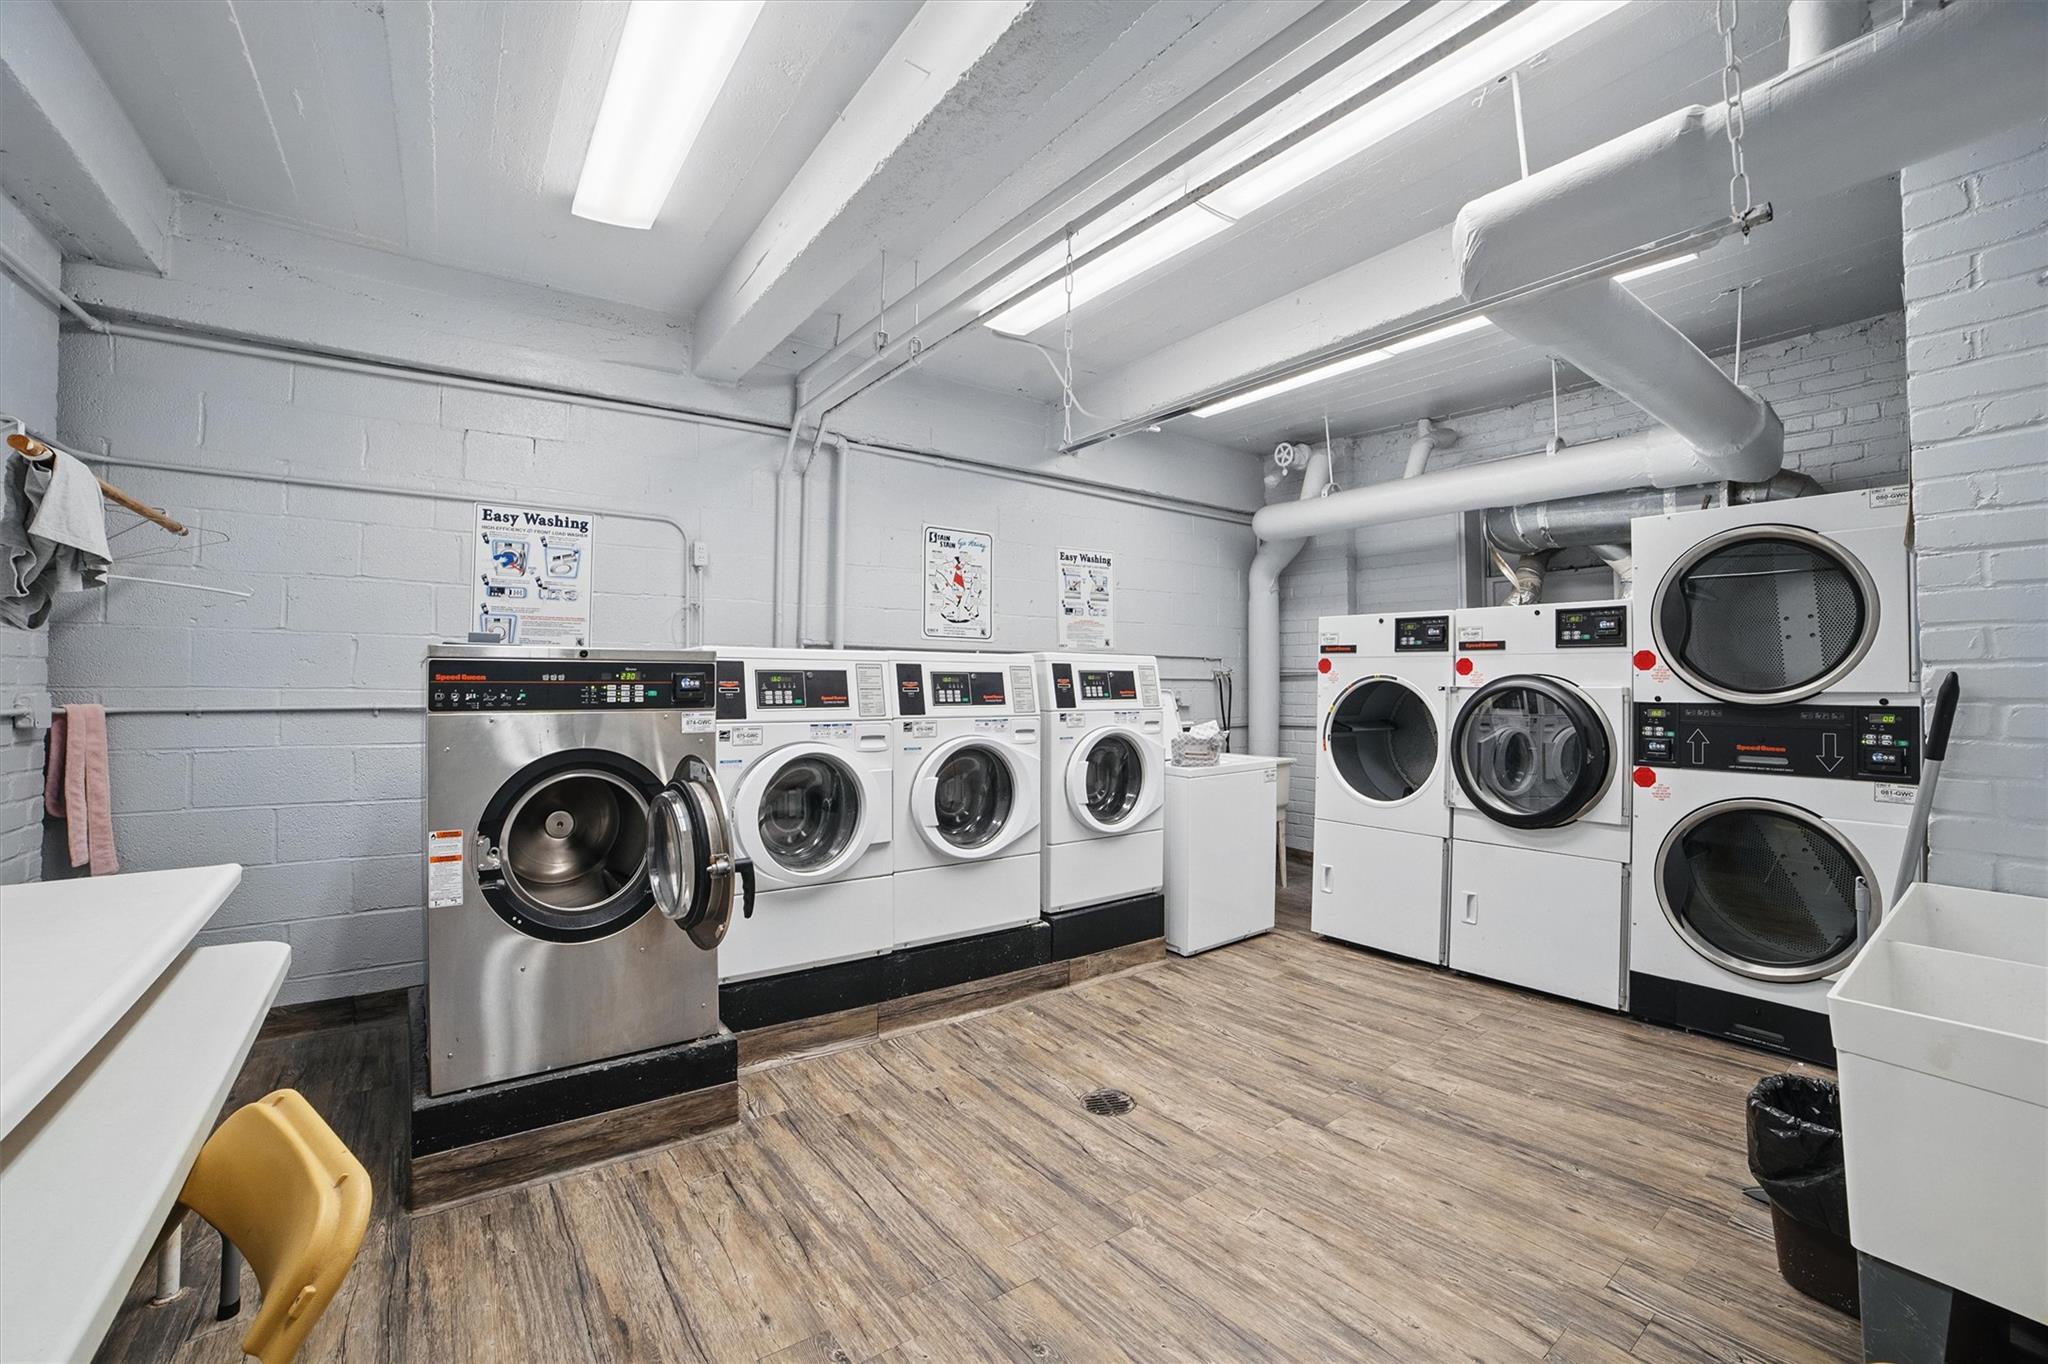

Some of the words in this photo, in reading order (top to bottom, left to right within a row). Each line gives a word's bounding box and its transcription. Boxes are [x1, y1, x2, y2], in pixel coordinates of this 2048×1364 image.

[481, 508, 519, 527] Easy
[523, 512, 589, 533] Washing
[939, 540, 955, 549] STAIN
[1059, 552, 1078, 563] Easy
[1079, 553, 1111, 566] Washing
[435, 674, 460, 682] Speed
